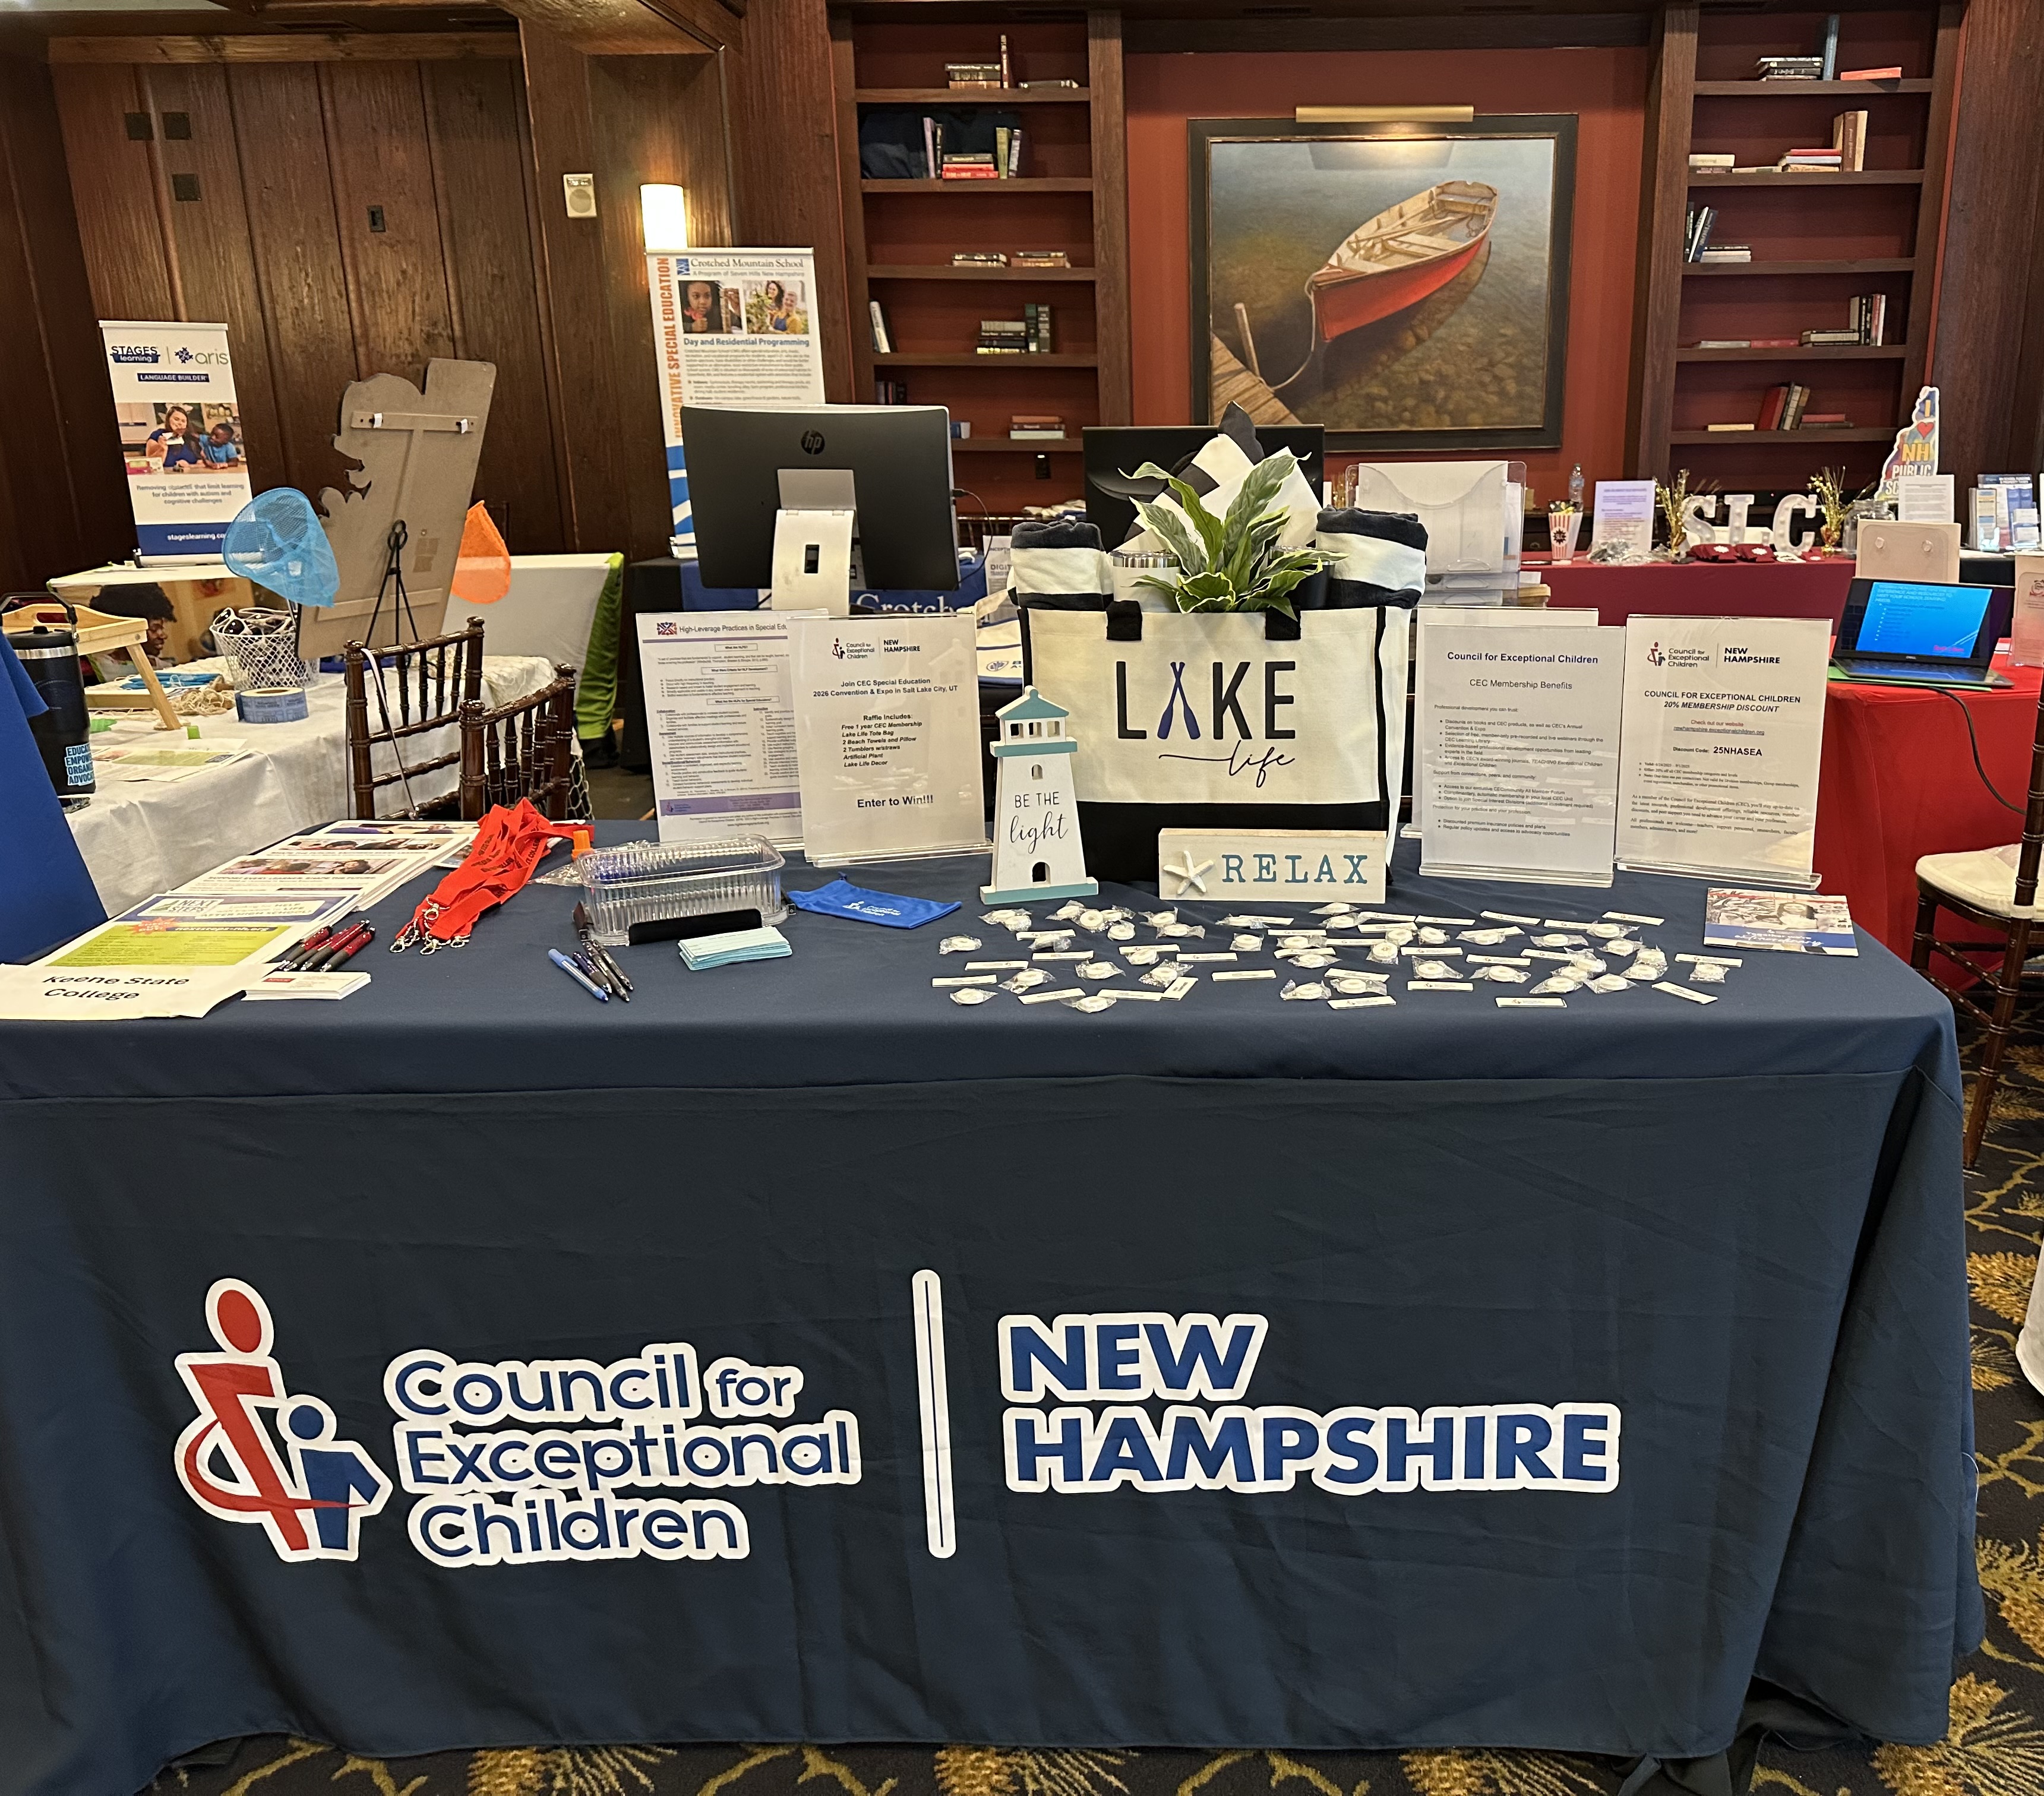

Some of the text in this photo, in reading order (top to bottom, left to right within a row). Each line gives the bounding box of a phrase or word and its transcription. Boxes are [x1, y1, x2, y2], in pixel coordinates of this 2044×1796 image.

[691, 258, 804, 267] Crotched Mountain School
[657, 258, 675, 321] EDUCATION
[111, 346, 157, 355] STAGES
[664, 325, 680, 369] SPECIAL
[684, 338, 699, 346] Day
[759, 339, 810, 347] Programming
[195, 349, 229, 365] aris
[1925, 400, 1931, 418] I
[804, 429, 823, 455] hp
[1902, 443, 1930, 461] NH
[1892, 464, 1931, 479] PUBLIC
[1448, 652, 1598, 664] Council for Exceptional Children
[1490, 679, 1538, 690] Membership
[1540, 681, 1573, 690] Benefits
[1116, 661, 1296, 740] LAKE
[1681, 702, 1735, 710] MEMBERSHIP
[1700, 693, 1756, 701] EXCEPTIONAL
[1713, 746, 1762, 756] 25NHASEA
[1159, 740, 1296, 788] life
[857, 798, 886, 808] Enter
[902, 795, 934, 805] Win!!!
[1015, 792, 1060, 808] BE THE
[1010, 811, 1069, 854] light
[1222, 854, 1367, 884] RELAX
[44, 988, 140, 1000] College
[1010, 1324, 1256, 1391] NEW
[394, 1354, 791, 1416] Council for
[406, 1421, 851, 1490] Exceptional
[1016, 1413, 1606, 1484] HAMPSHIRE
[419, 1490, 738, 1557] Children
